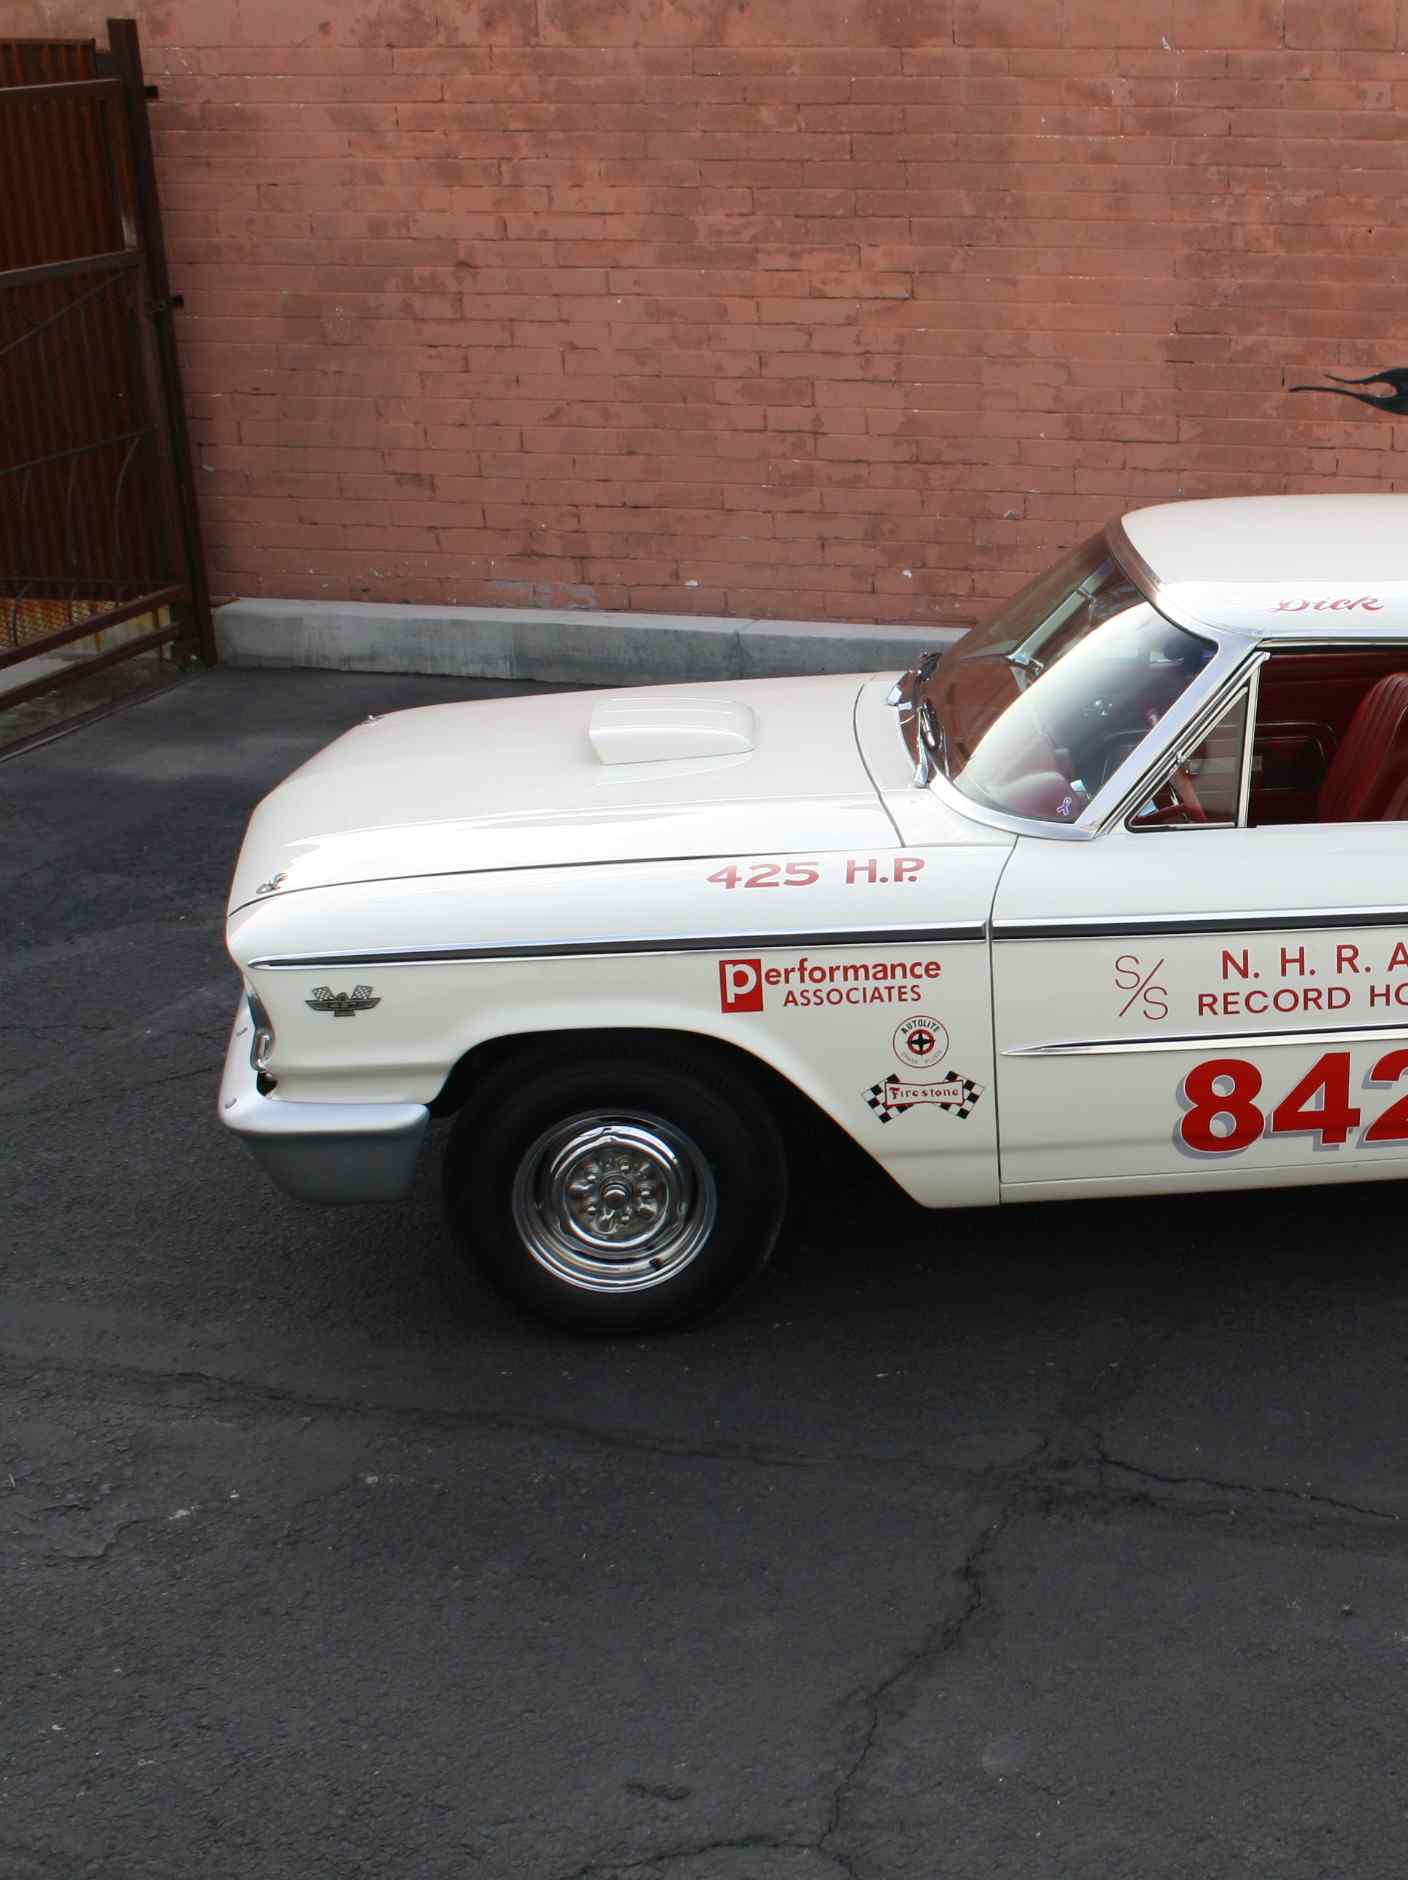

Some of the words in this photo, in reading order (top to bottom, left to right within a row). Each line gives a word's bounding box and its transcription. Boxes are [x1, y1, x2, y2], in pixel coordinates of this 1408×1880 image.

[706, 862, 820, 889] 425
[845, 857, 926, 884] H.P.
[782, 984, 922, 1007] ASSOCIATES
[1197, 985, 1351, 1017] RECORD
[888, 1086, 959, 1100] Firestone
